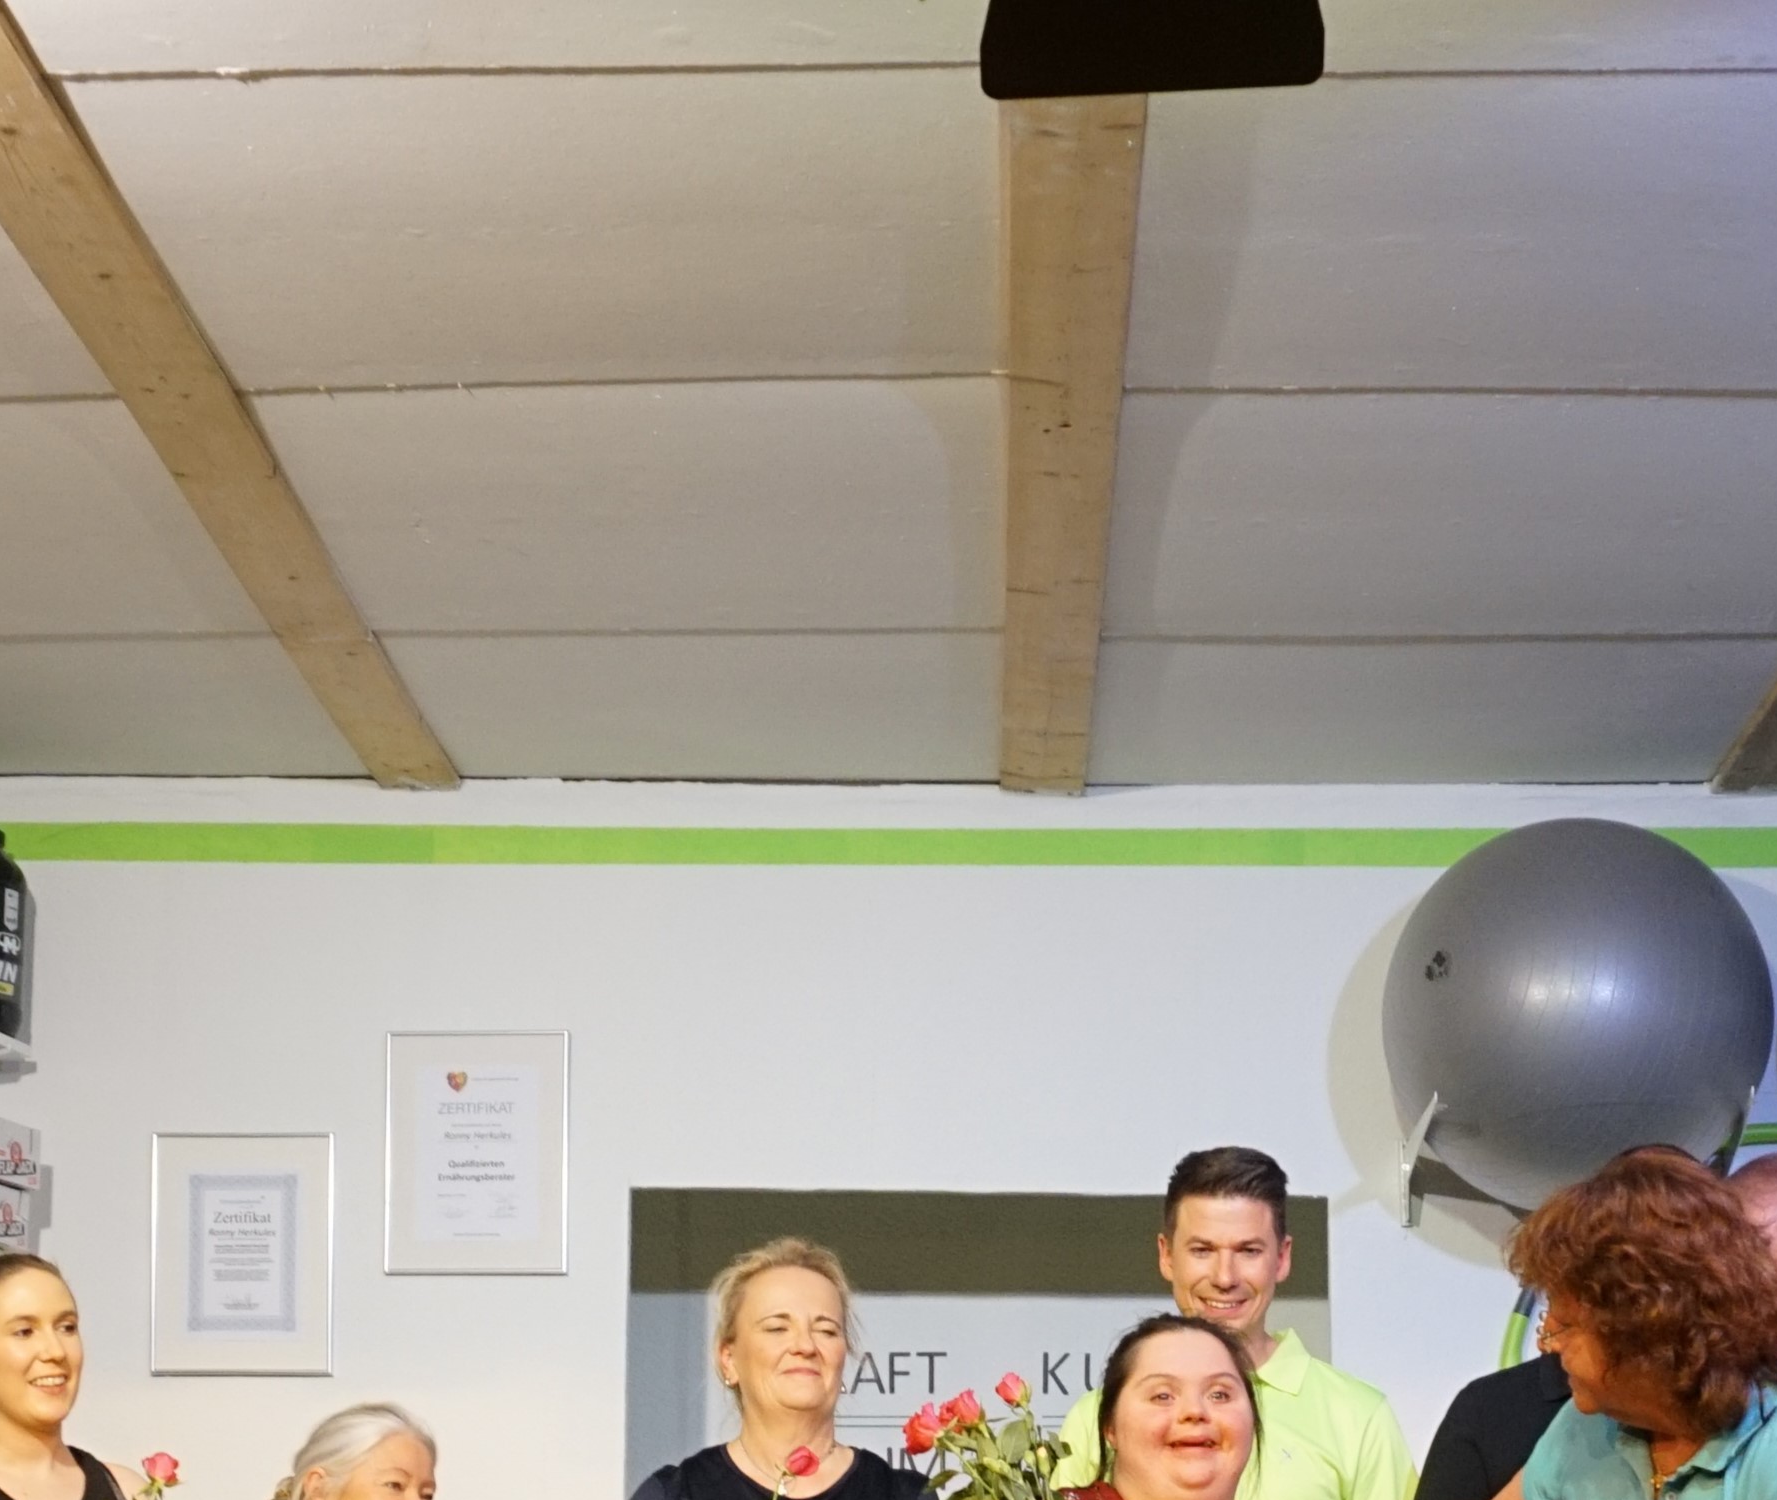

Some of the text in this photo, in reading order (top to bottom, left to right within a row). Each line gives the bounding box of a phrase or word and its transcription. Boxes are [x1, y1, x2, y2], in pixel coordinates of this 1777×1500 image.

[438, 1101, 515, 1115] ZERTIFIKAT
[448, 1159, 505, 1170] Qualifizierten
[437, 1172, 515, 1183] Ernährungsberater
[213, 1211, 272, 1224] Zertifikat
[840, 1351, 948, 1395] AFT
